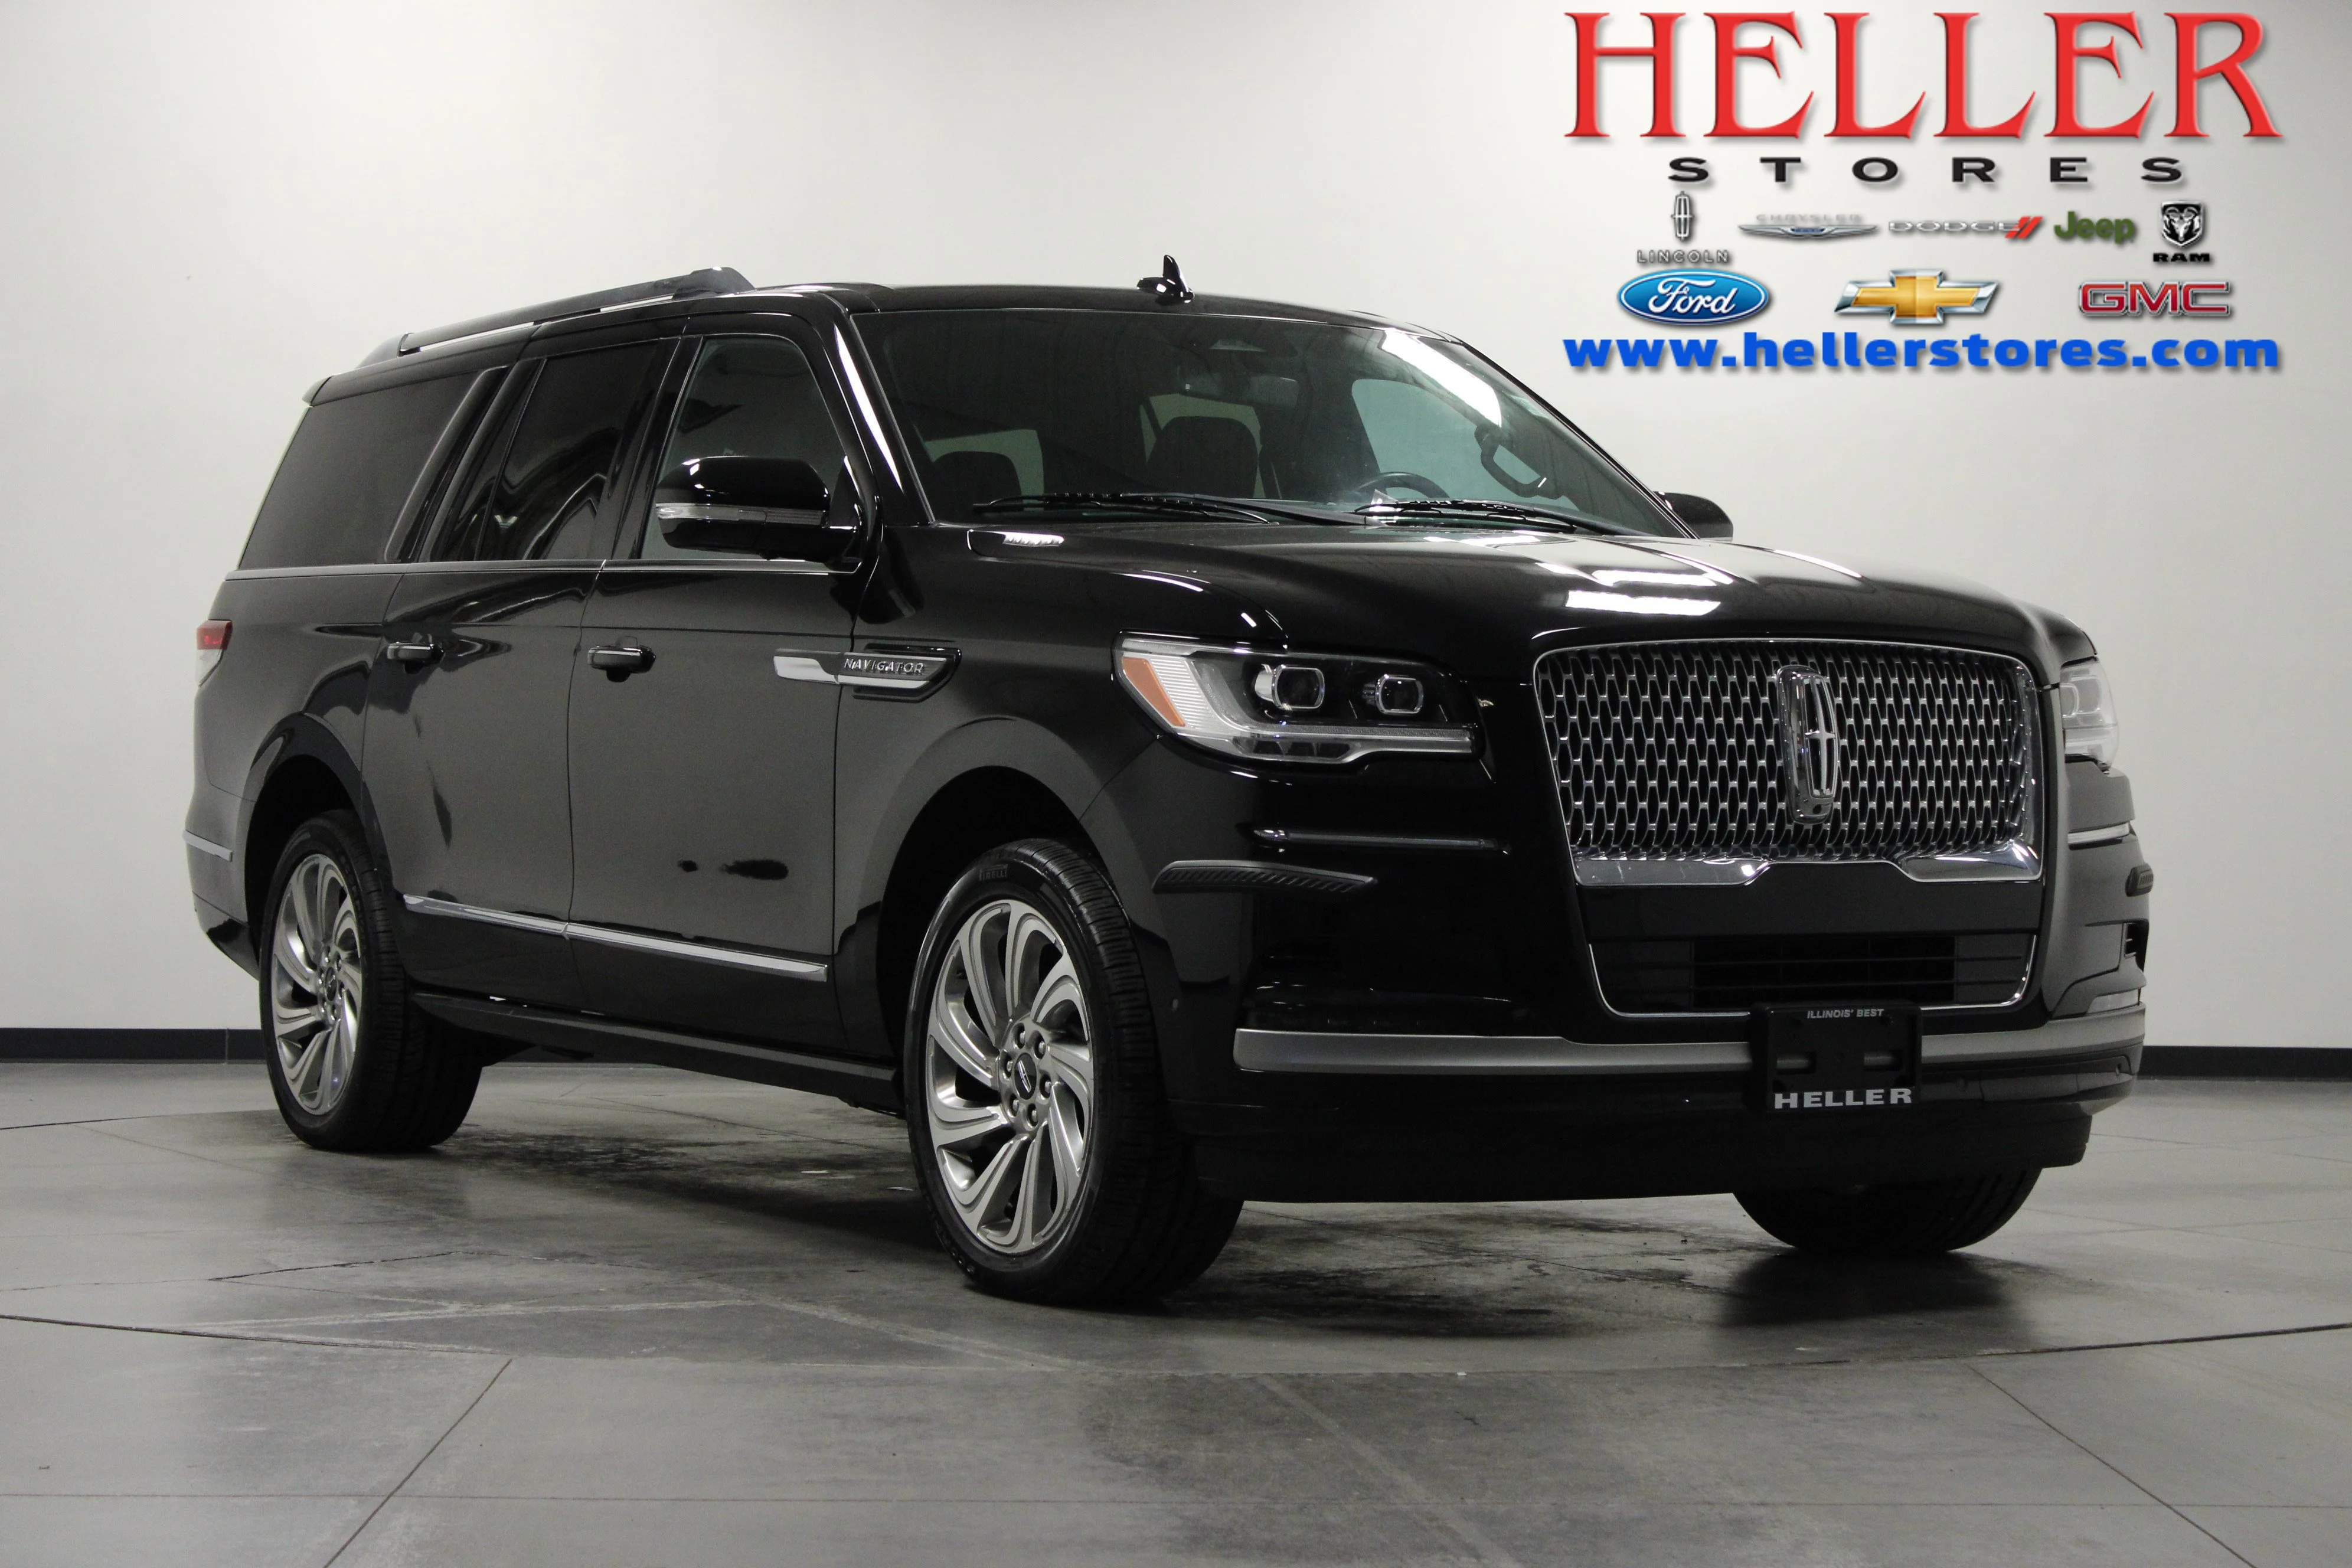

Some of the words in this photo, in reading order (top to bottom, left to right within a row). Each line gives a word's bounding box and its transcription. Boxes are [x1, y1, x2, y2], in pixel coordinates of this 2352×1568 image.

[844, 658, 925, 674] NAVIGATOR
[979, 864, 1009, 881] PIRELLI
[1807, 1009, 1854, 1019] ILLINOIS'
[1856, 1008, 1884, 1018] BEST
[1774, 1087, 1912, 1109] HELLER
